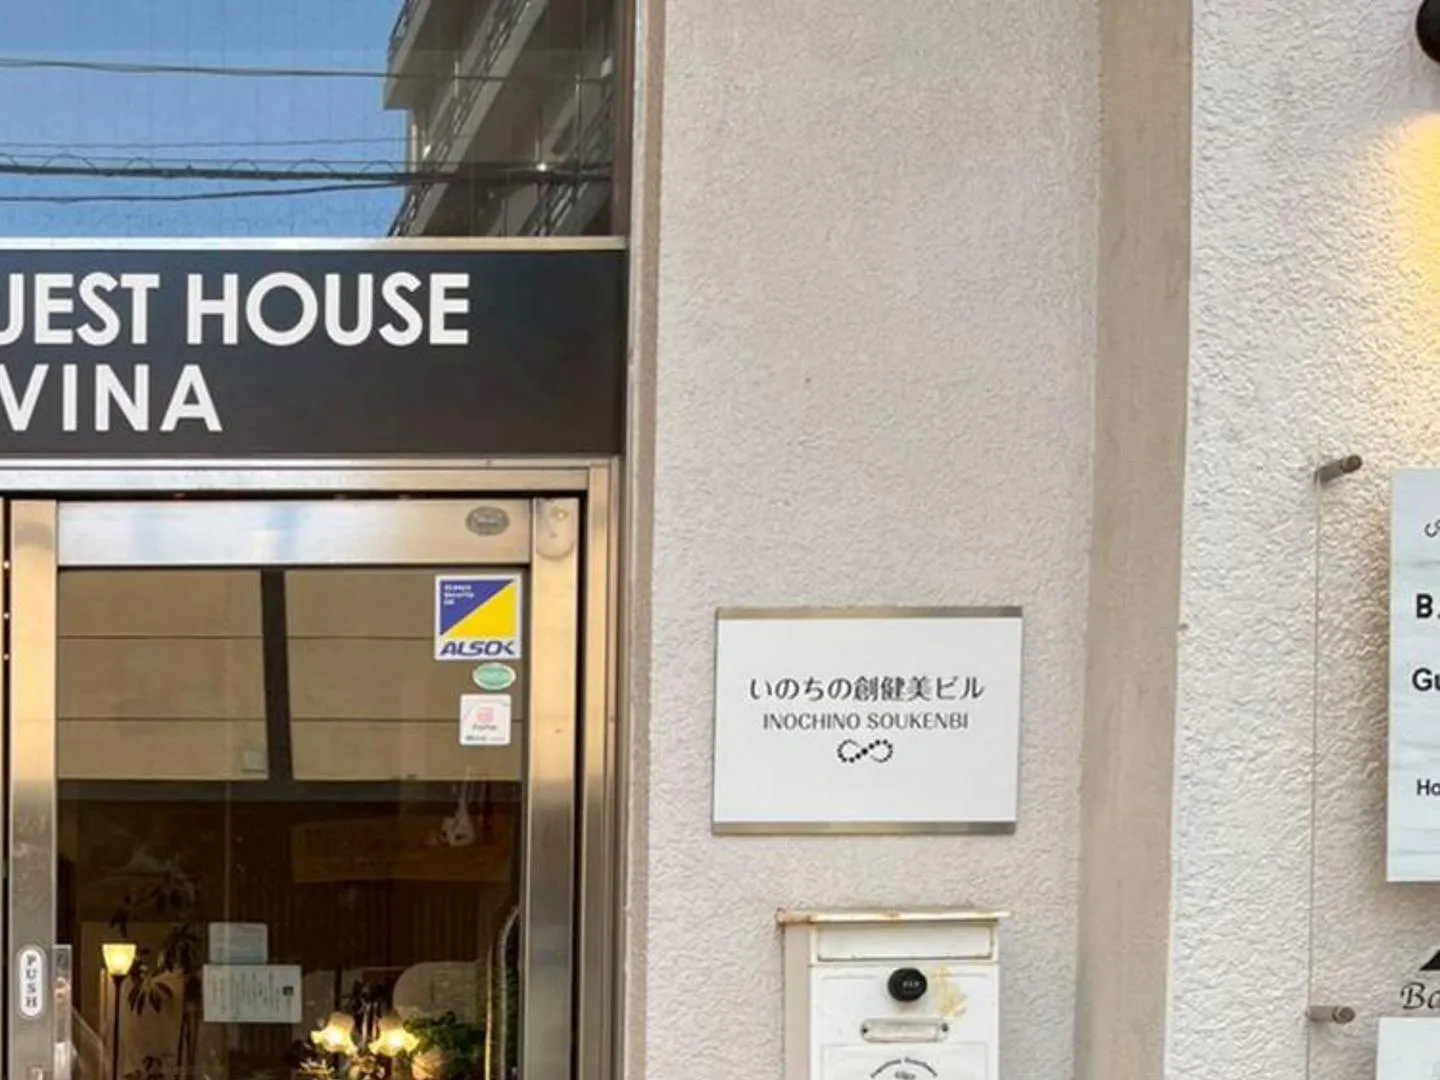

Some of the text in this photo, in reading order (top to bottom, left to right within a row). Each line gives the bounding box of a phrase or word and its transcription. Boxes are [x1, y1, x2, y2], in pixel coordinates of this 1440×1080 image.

[189, 271, 470, 346] HOUSE
[1416, 593, 1440, 619] B
[440, 640, 515, 656] ALSOK
[749, 675, 985, 702] いのちの創健美ビル
[762, 712, 969, 730] INOCHINO SOUKENBI
[25, 953, 37, 1008] PUSH
